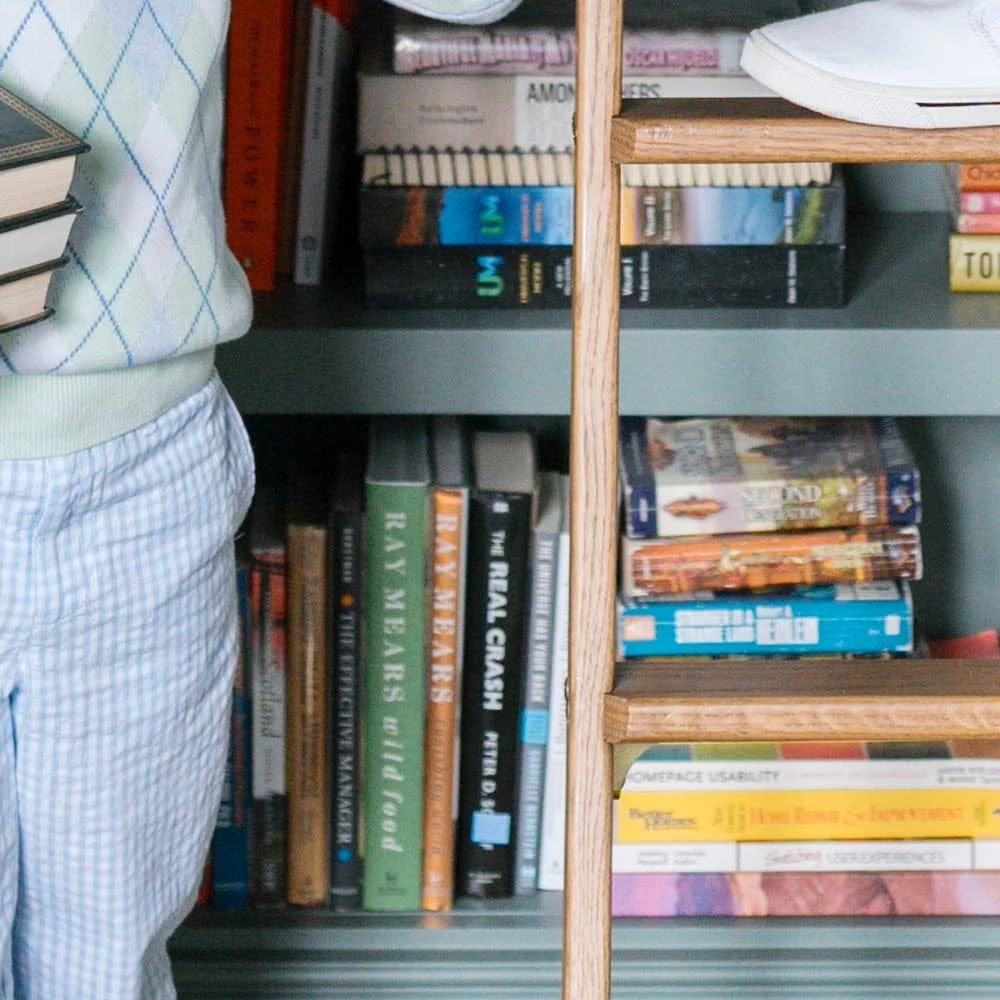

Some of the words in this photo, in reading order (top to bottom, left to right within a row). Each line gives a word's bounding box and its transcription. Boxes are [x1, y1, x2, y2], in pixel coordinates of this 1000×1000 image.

[527, 83, 577, 102] AMON
[476, 254, 505, 297] UM
[963, 251, 1000, 279] TO
[383, 510, 407, 578] RAY
[434, 512, 458, 579] RAY
[490, 530, 505, 556] THE
[486, 561, 509, 623] REAL
[341, 611, 356, 648] THE
[382, 587, 406, 704] MEARS
[431, 588, 456, 705] MEARS
[483, 628, 506, 711] CRASH
[338, 652, 355, 752] EFFECTIVE
[382, 715, 404, 782] wild
[481, 730, 499, 777] PETER
[335, 755, 353, 845] MANAGER
[381, 793, 404, 853] food
